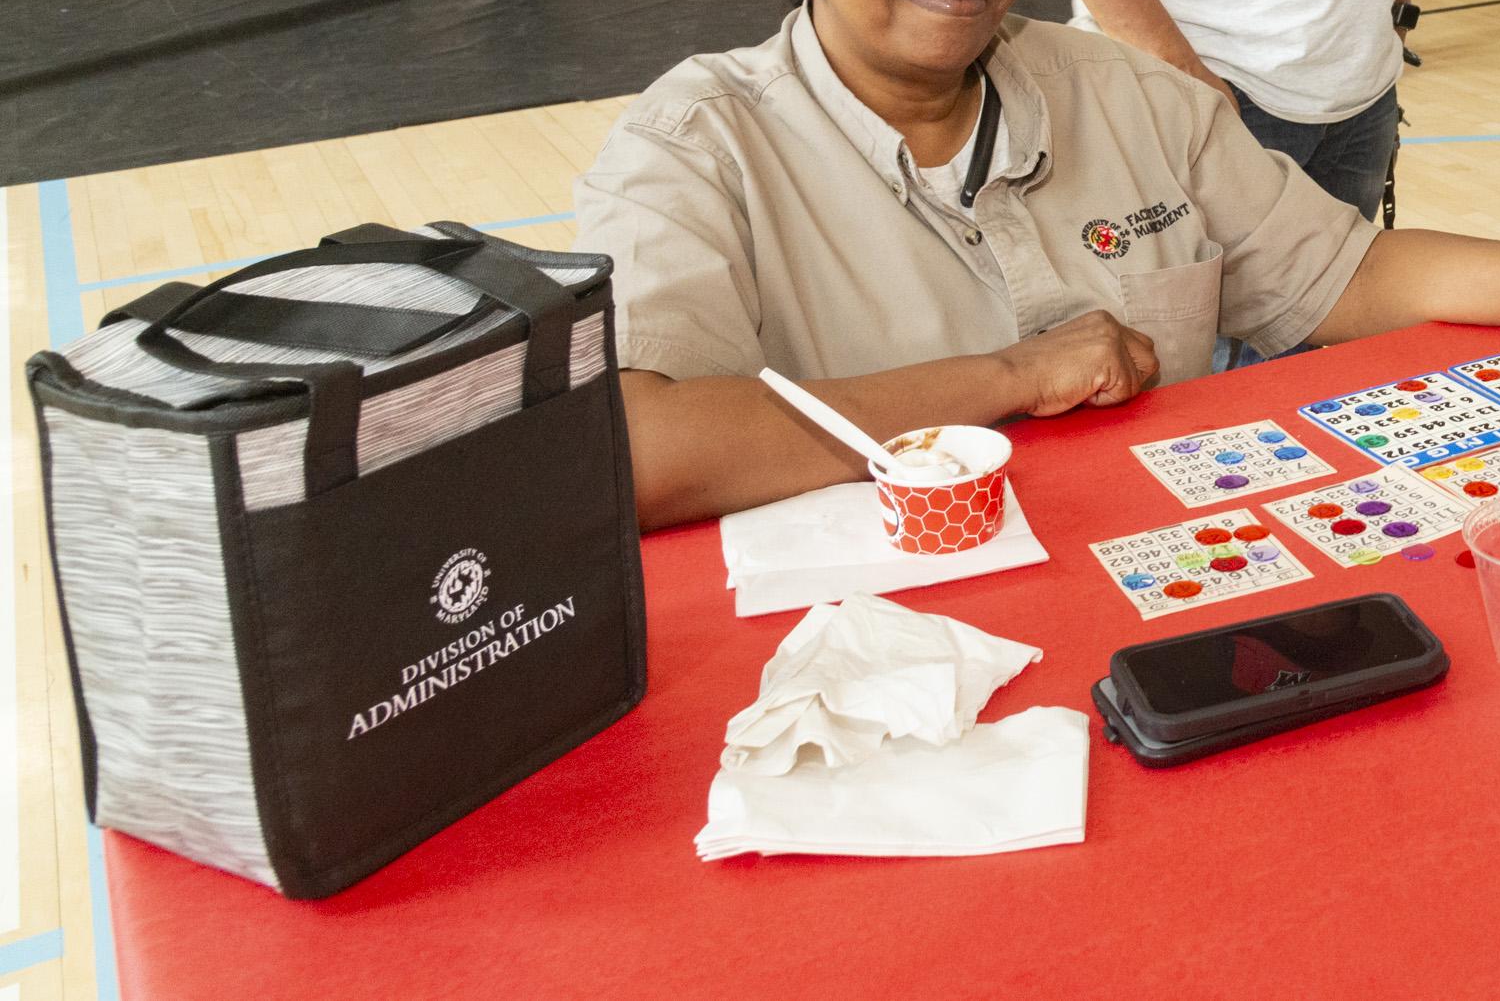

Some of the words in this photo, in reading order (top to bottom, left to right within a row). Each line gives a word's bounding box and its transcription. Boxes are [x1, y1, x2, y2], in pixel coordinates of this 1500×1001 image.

[1460, 364, 1484, 373] 65
[1366, 389, 1392, 398] 35
[1339, 397, 1362, 406] 51
[1383, 399, 1410, 408] 32
[1429, 402, 1456, 412] 28
[1476, 406, 1499, 415] 13
[1326, 414, 1352, 424] 68
[1374, 417, 1400, 427] 53
[1449, 412, 1475, 422] 30
[1345, 425, 1371, 435] 65
[1421, 420, 1446, 430] 44
[1469, 423, 1495, 433] 25
[1222, 432, 1244, 441] 29
[1393, 428, 1418, 438] 59
[1440, 431, 1466, 441] 45
[1412, 439, 1438, 449] 55
[1144, 448, 1167, 458] 66
[1179, 453, 1200, 462] 46
[1382, 447, 1411, 458] 72
[1153, 459, 1176, 467] 65
[1189, 462, 1212, 471] 58
[1253, 458, 1275, 467] 25
[1165, 467, 1186, 476] 61
[1226, 464, 1247, 473] 43
[1264, 467, 1284, 477] 24
[1174, 477, 1195, 485] 72
[1199, 471, 1223, 481] 55
[1383, 475, 1394, 483] 7
[1183, 485, 1207, 494] 68
[1326, 488, 1349, 498] 33
[1366, 489, 1389, 500] 28
[1301, 497, 1324, 507] 55
[1276, 503, 1299, 514] 73
[1394, 507, 1418, 518] 25
[1221, 518, 1234, 527] 8
[1368, 516, 1392, 526] 34
[1304, 523, 1327, 533] 61
[1158, 530, 1182, 540] 33
[1128, 537, 1153, 548] 53
[1360, 535, 1382, 546] 57
[1099, 545, 1124, 555] 68
[1168, 542, 1192, 552] 38
[1331, 542, 1356, 554] 62
[1137, 549, 1161, 560] 46
[1252, 550, 1264, 561] 4
[1108, 556, 1133, 567] 62
[1147, 561, 1171, 571] 49
[432, 548, 477, 588] UNIVERSITY
[1187, 565, 1211, 576] 45
[1257, 562, 1282, 572] 13
[1156, 572, 1182, 583] 58
[1229, 569, 1252, 580] 16
[1138, 591, 1162, 601] 61
[436, 586, 489, 624] MARYLAND
[401, 620, 496, 685] DIVISION
[500, 603, 526, 629] OF
[346, 596, 576, 740] ADMINISTRATION
